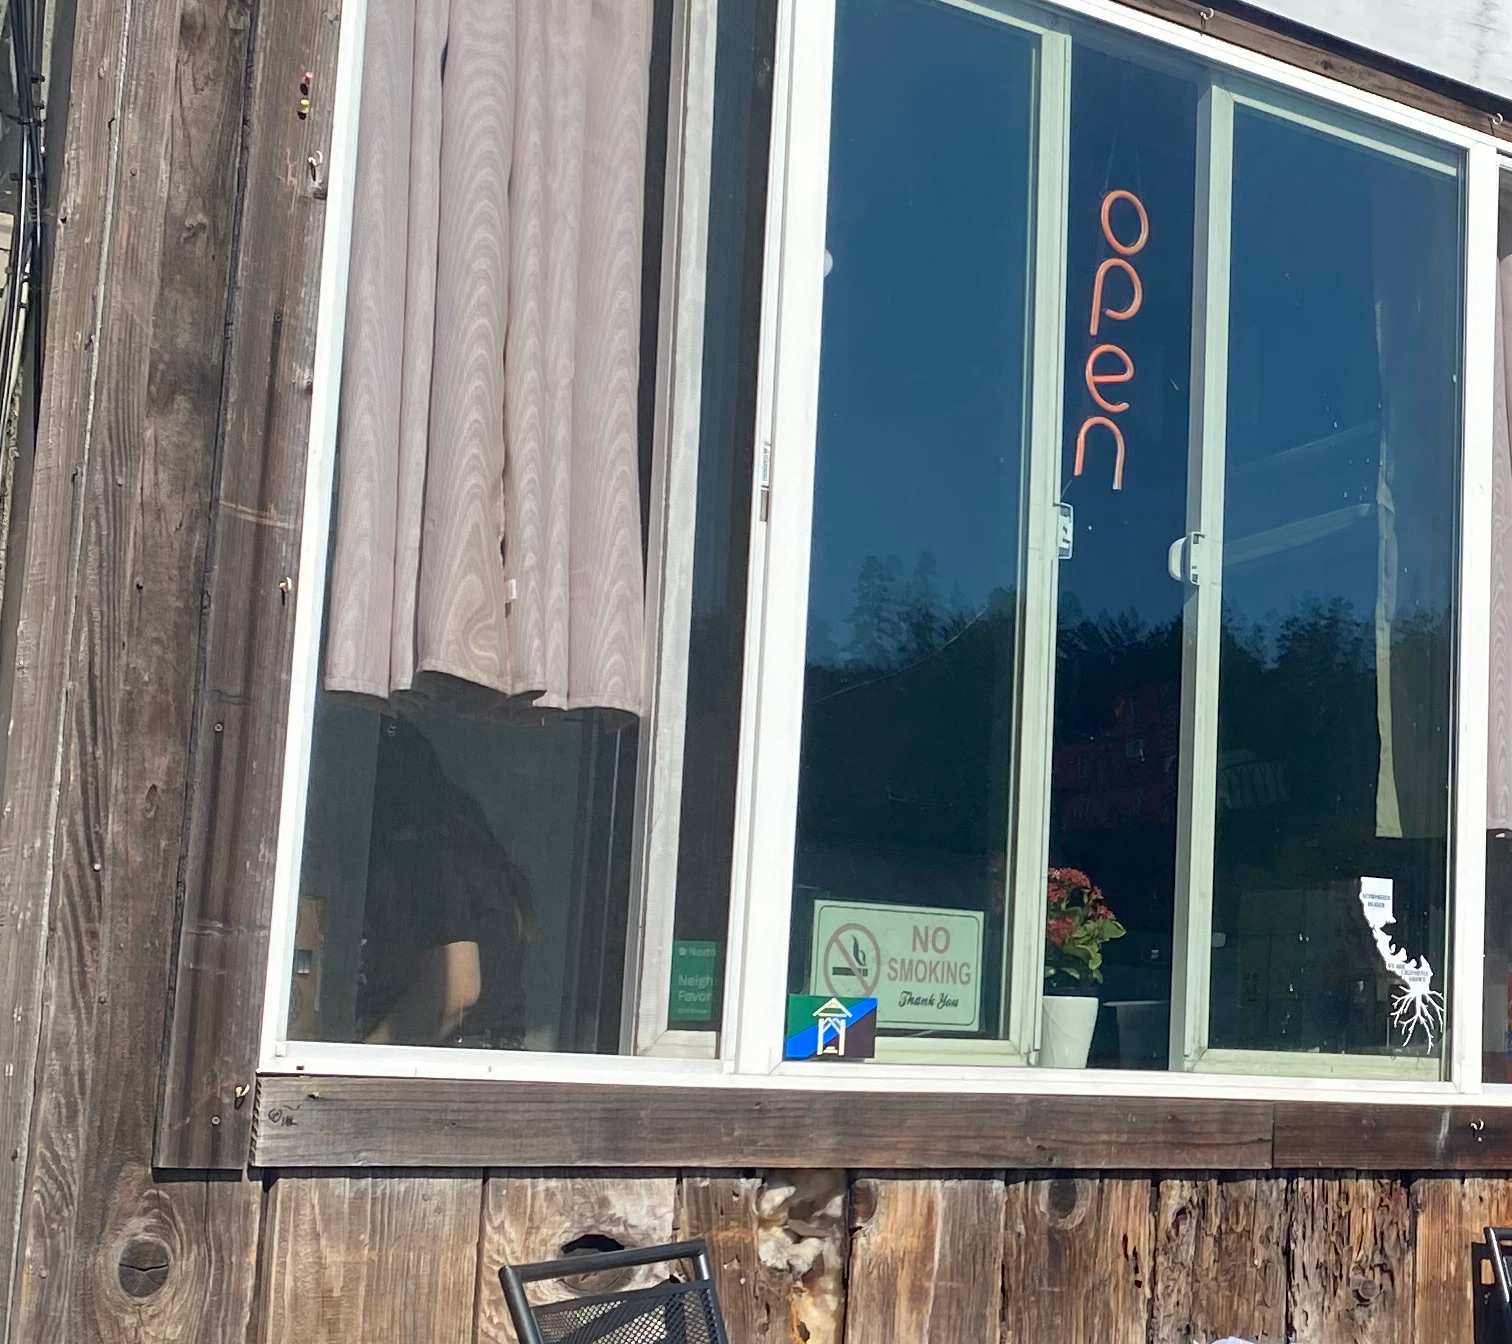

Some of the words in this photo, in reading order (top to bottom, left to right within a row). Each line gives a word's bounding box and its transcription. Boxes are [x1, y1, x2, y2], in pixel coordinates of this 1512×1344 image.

[1074, 190, 1149, 490] open
[912, 924, 951, 954] NO
[887, 958, 971, 985] SMOKING
[898, 990, 934, 1007] Thank
[937, 992, 959, 1010] You
